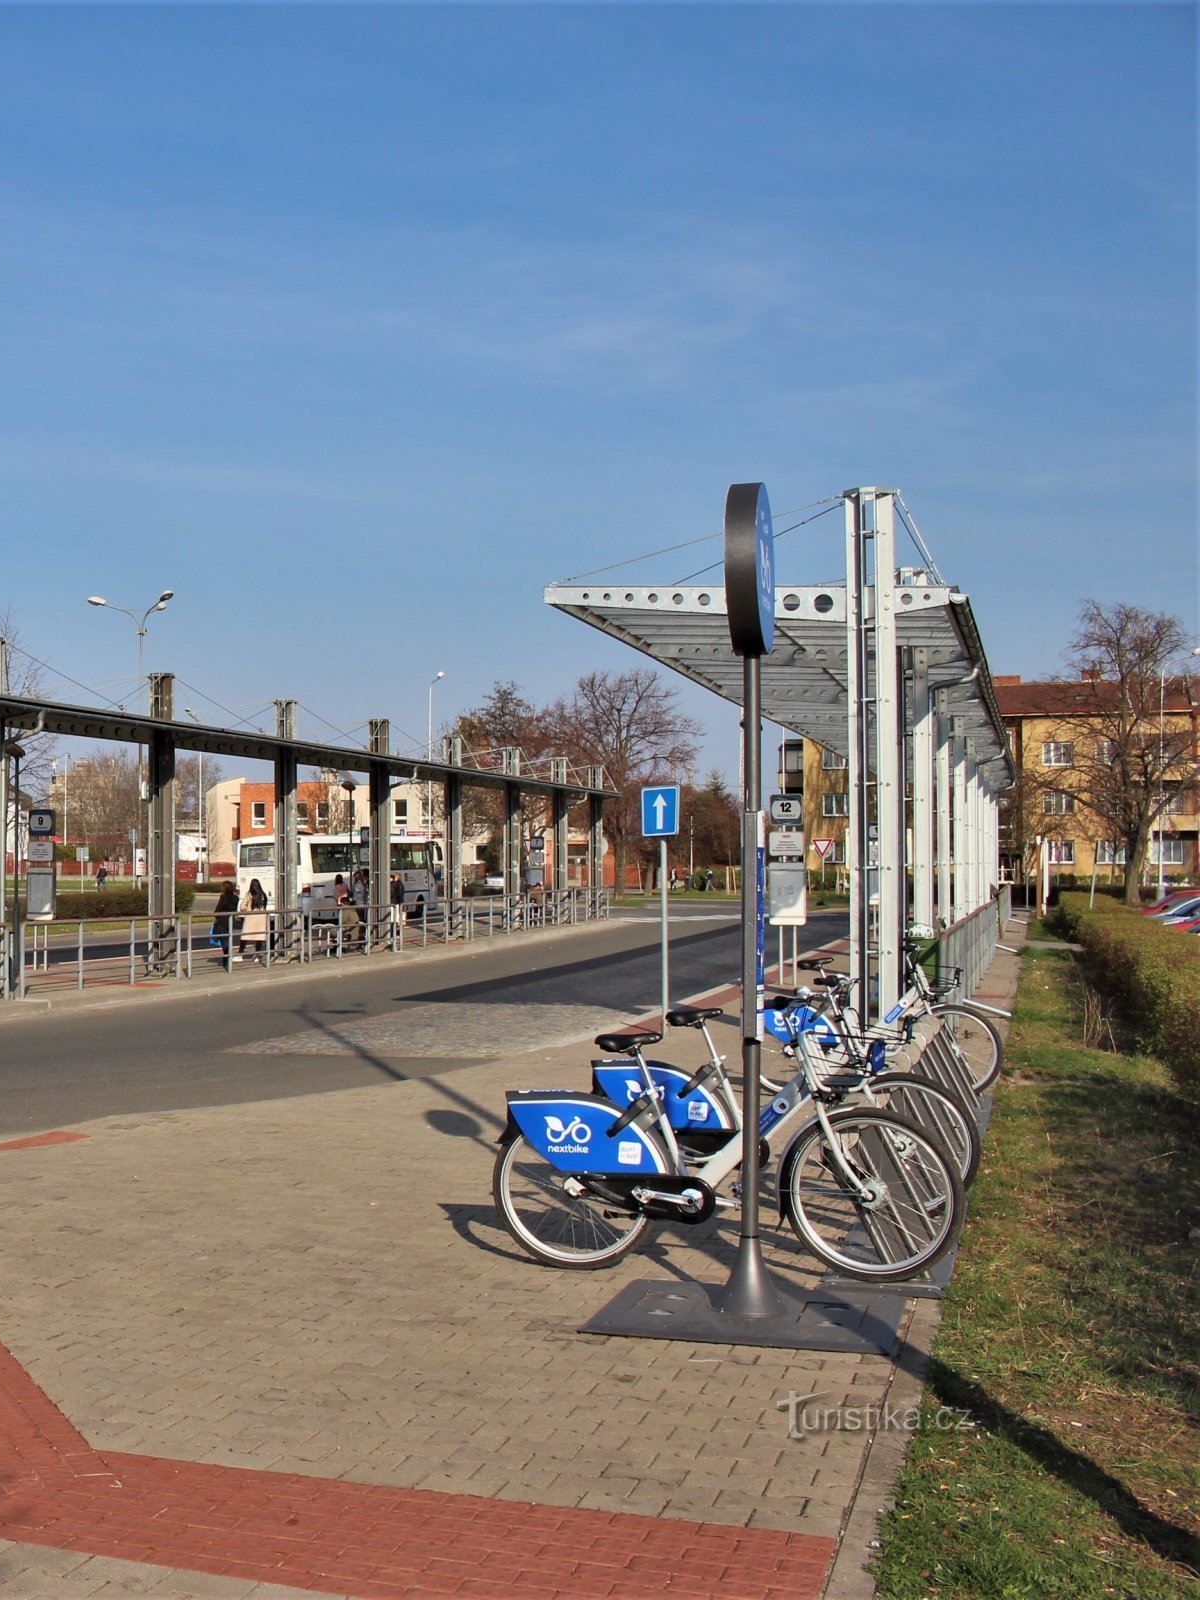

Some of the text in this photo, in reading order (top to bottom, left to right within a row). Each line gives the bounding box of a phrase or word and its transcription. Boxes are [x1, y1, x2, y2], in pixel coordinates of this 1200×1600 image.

[779, 802, 792, 813] 12
[37, 816, 44, 826] 9
[547, 1144, 590, 1154] nextbike
